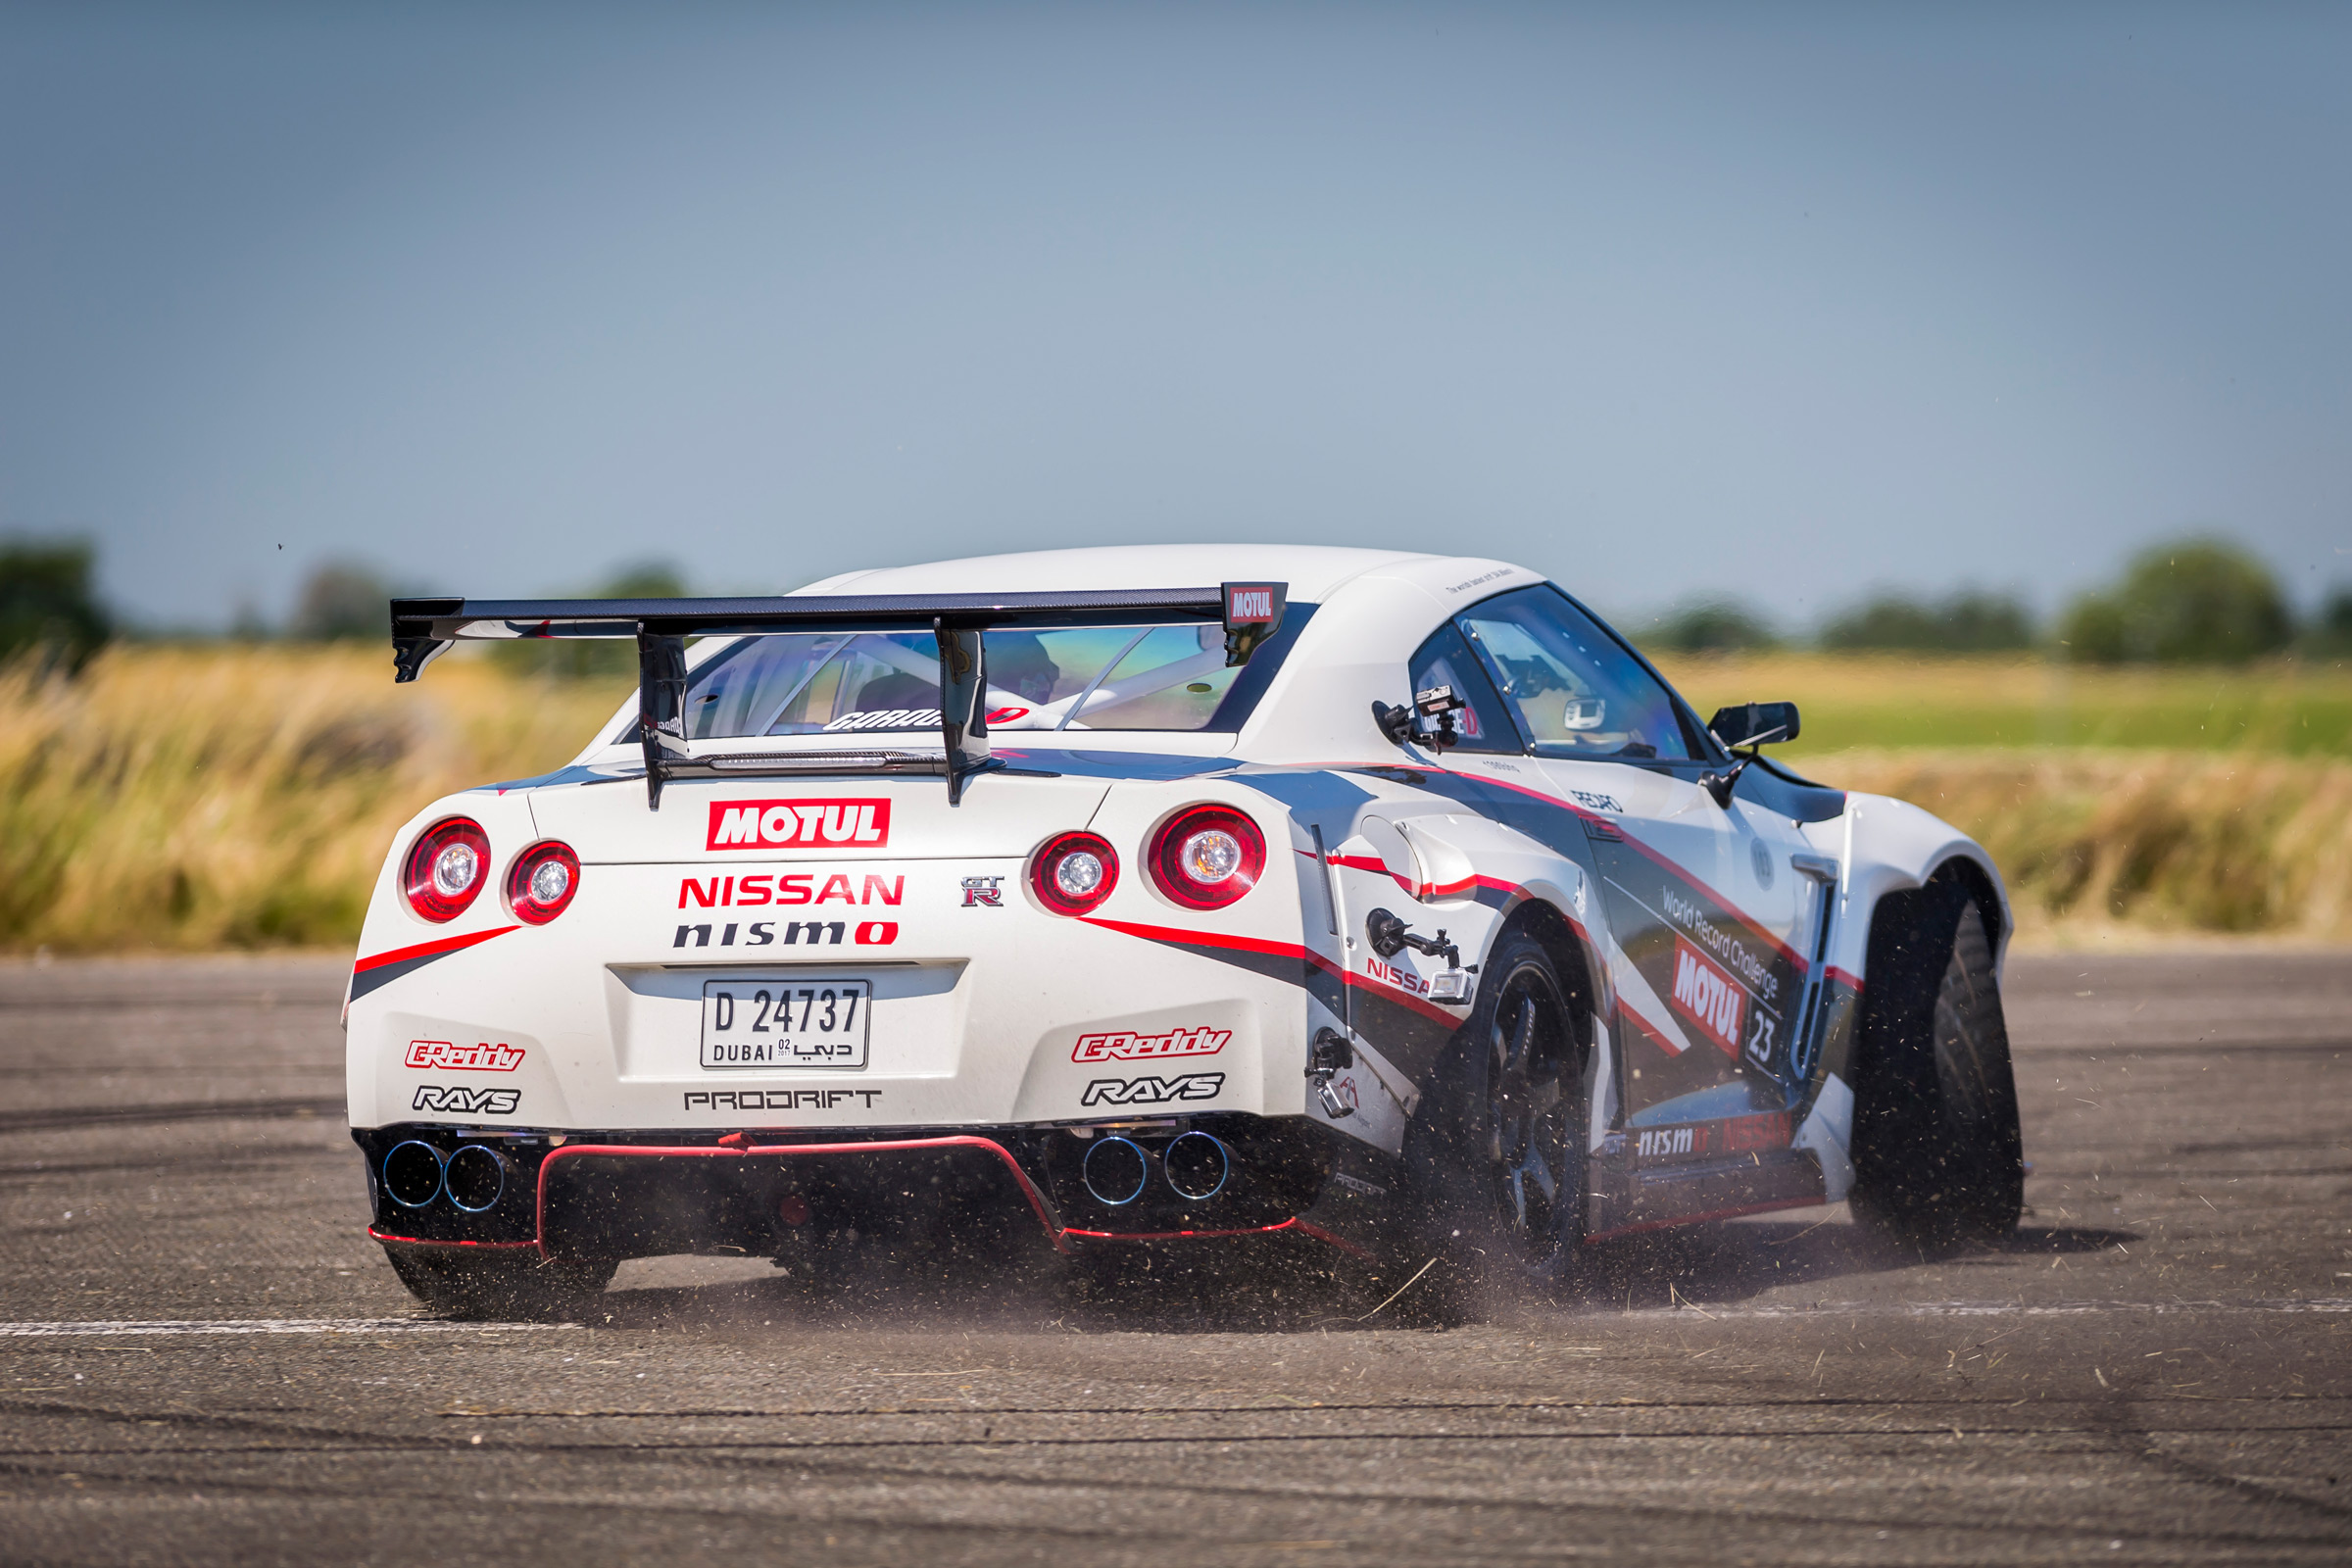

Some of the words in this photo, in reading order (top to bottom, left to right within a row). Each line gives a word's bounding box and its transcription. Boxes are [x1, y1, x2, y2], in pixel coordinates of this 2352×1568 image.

[1232, 592, 1272, 617] MOTUL
[713, 805, 882, 844] MOTUL
[678, 874, 906, 909] NISSAN
[672, 920, 900, 949] nismo
[1663, 885, 1694, 930] World
[1694, 909, 1732, 959] Record
[1731, 939, 1779, 1000] Challenge
[1367, 957, 1430, 995] NISSA
[715, 992, 734, 1031] D
[752, 989, 859, 1033] 24737
[1674, 949, 1740, 1047] MOTUL
[713, 1045, 772, 1061] DUBAI
[778, 1039, 791, 1050] 02
[794, 1045, 853, 1061] دبي
[1071, 1026, 1233, 1063] GReddy
[1748, 1009, 1776, 1063] 23
[405, 1040, 526, 1072] GReddy
[412, 1085, 522, 1114] RAYS
[683, 1090, 882, 1110] PRODRIFT
[1080, 1071, 1226, 1106] RAYS
[1638, 1126, 1708, 1156] nismo
[1722, 1111, 1792, 1152] NISSAN
